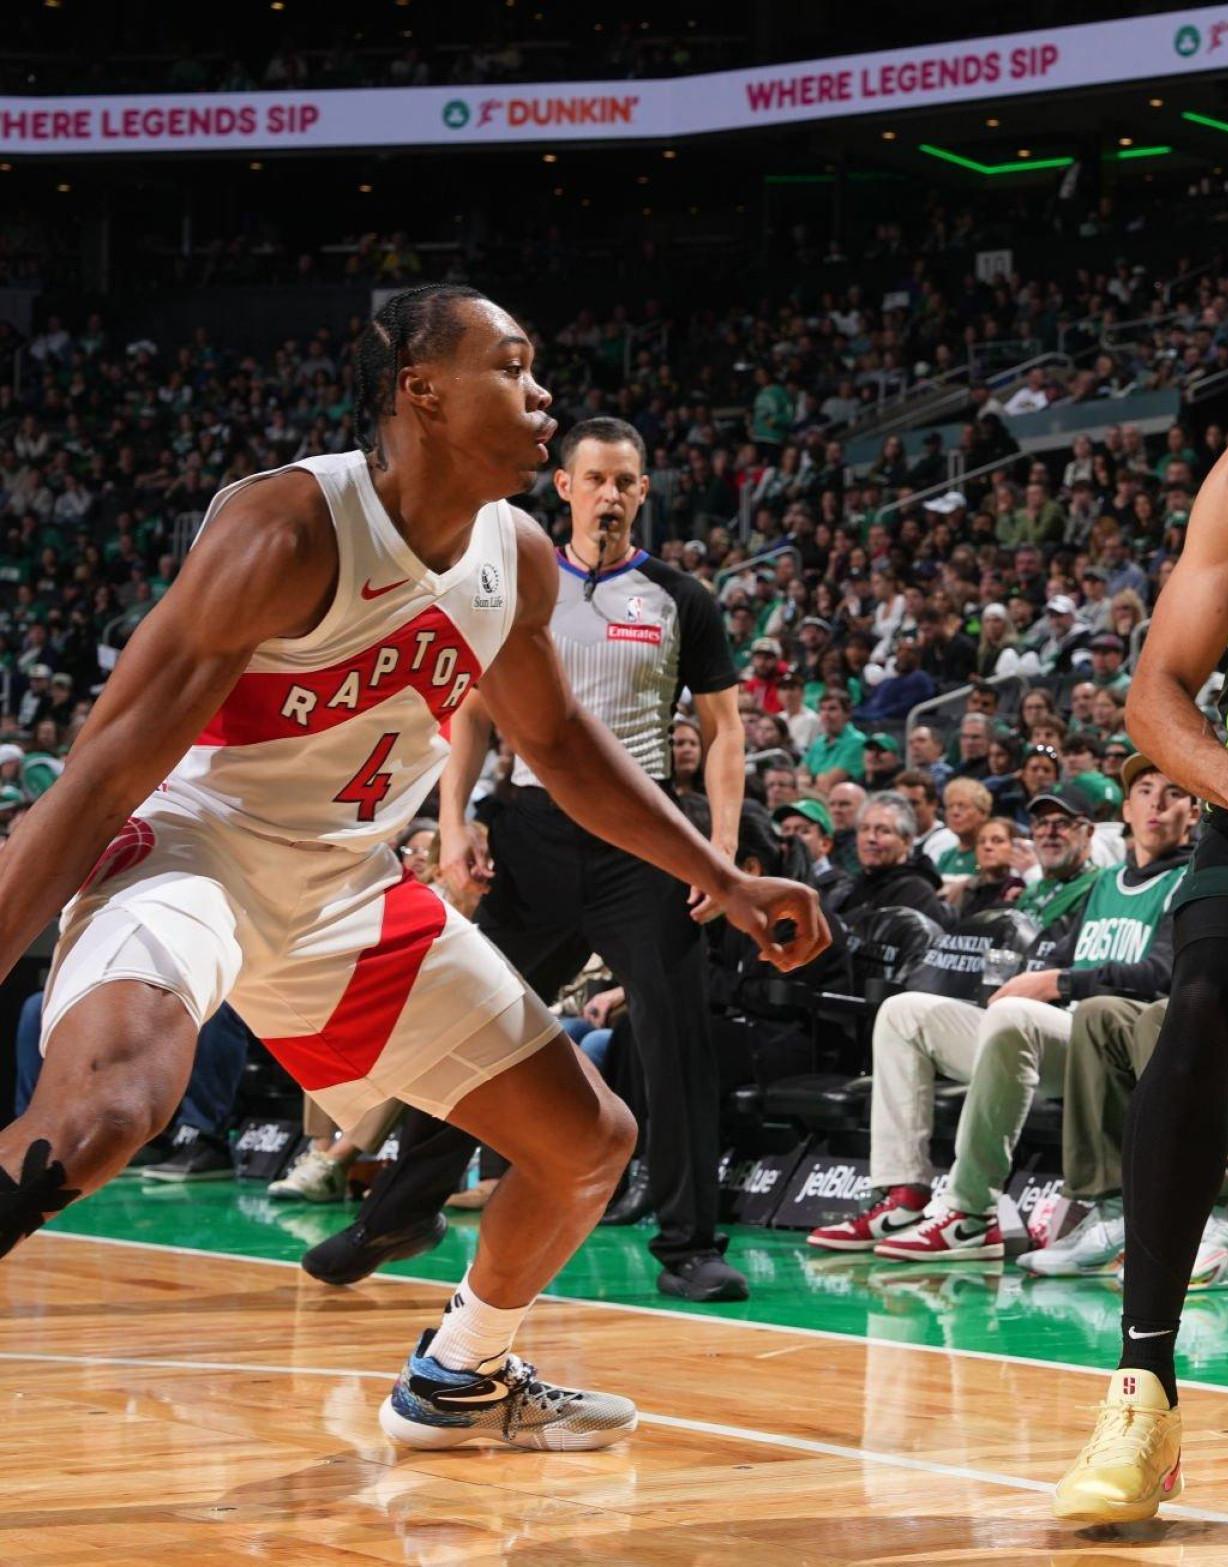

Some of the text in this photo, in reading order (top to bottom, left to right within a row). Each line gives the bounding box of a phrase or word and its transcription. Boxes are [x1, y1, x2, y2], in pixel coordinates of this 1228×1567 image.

[746, 44, 1058, 111] WHERE LEGENDS SIP
[102, 106, 257, 138] LEGENDS
[266, 104, 319, 134] SIP
[508, 97, 640, 126] DUNKIN'
[473, 596, 503, 608] Sun Life
[608, 625, 660, 639] Emirates
[332, 732, 401, 822] 4
[1074, 917, 1151, 963] BOSTON
